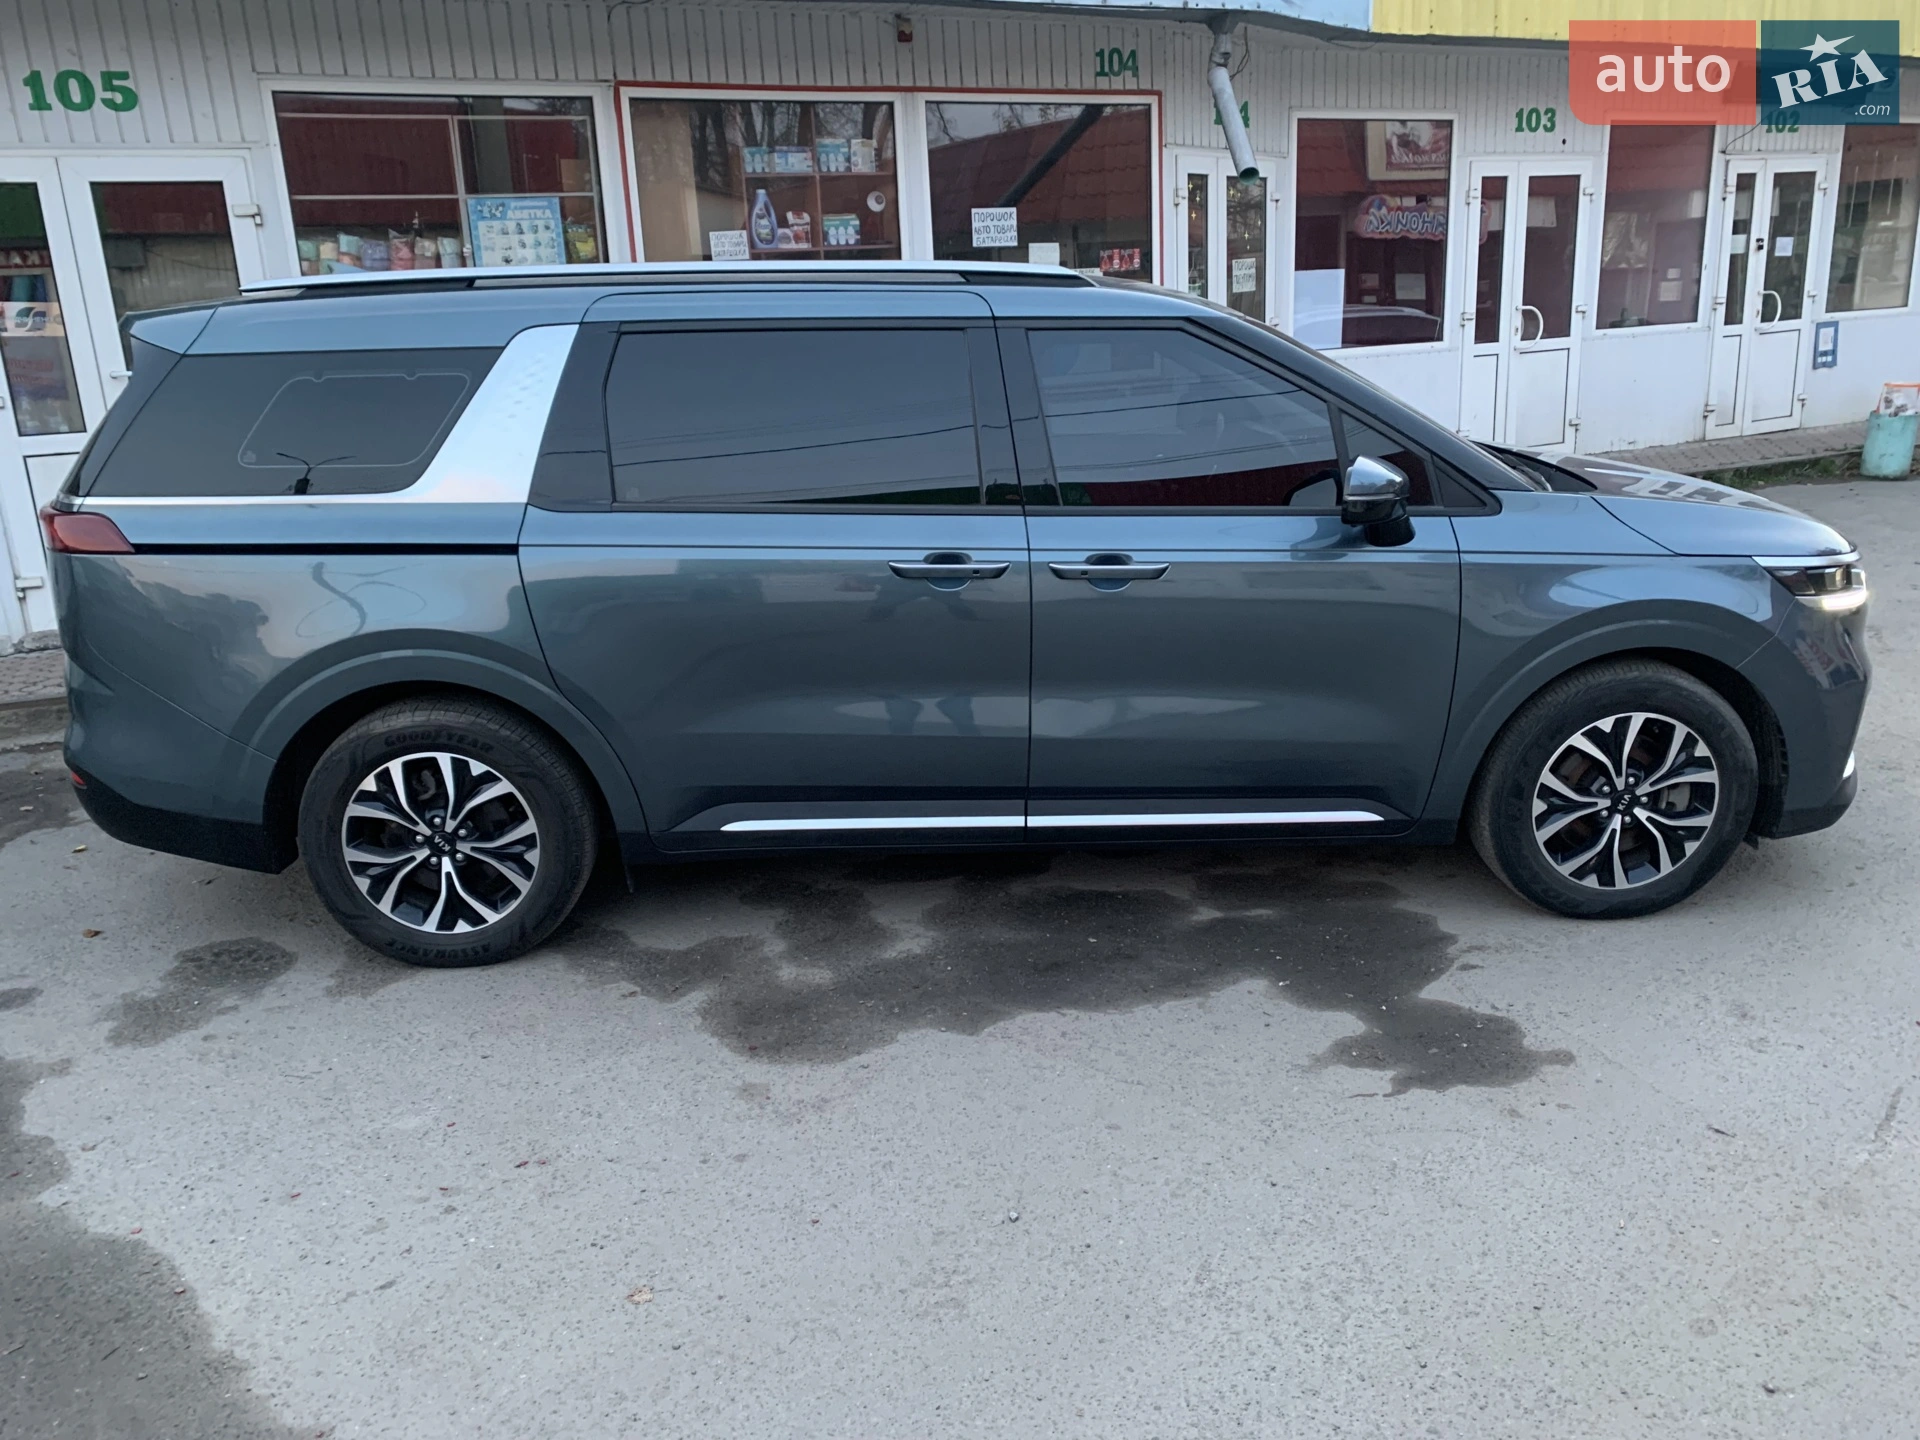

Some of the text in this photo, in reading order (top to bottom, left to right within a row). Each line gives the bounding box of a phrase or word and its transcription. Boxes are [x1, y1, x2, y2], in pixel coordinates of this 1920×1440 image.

[1095, 47, 1139, 77] 104
[22, 69, 139, 112] 105
[1214, 100, 1250, 128] 14
[1515, 107, 1556, 133] 103
[1765, 110, 1801, 133] 102
[974, 211, 1015, 222] ПОРОШОК
[974, 225, 991, 235] АВТО
[1616, 794, 1632, 811] KIA
[433, 835, 451, 852] KIA
